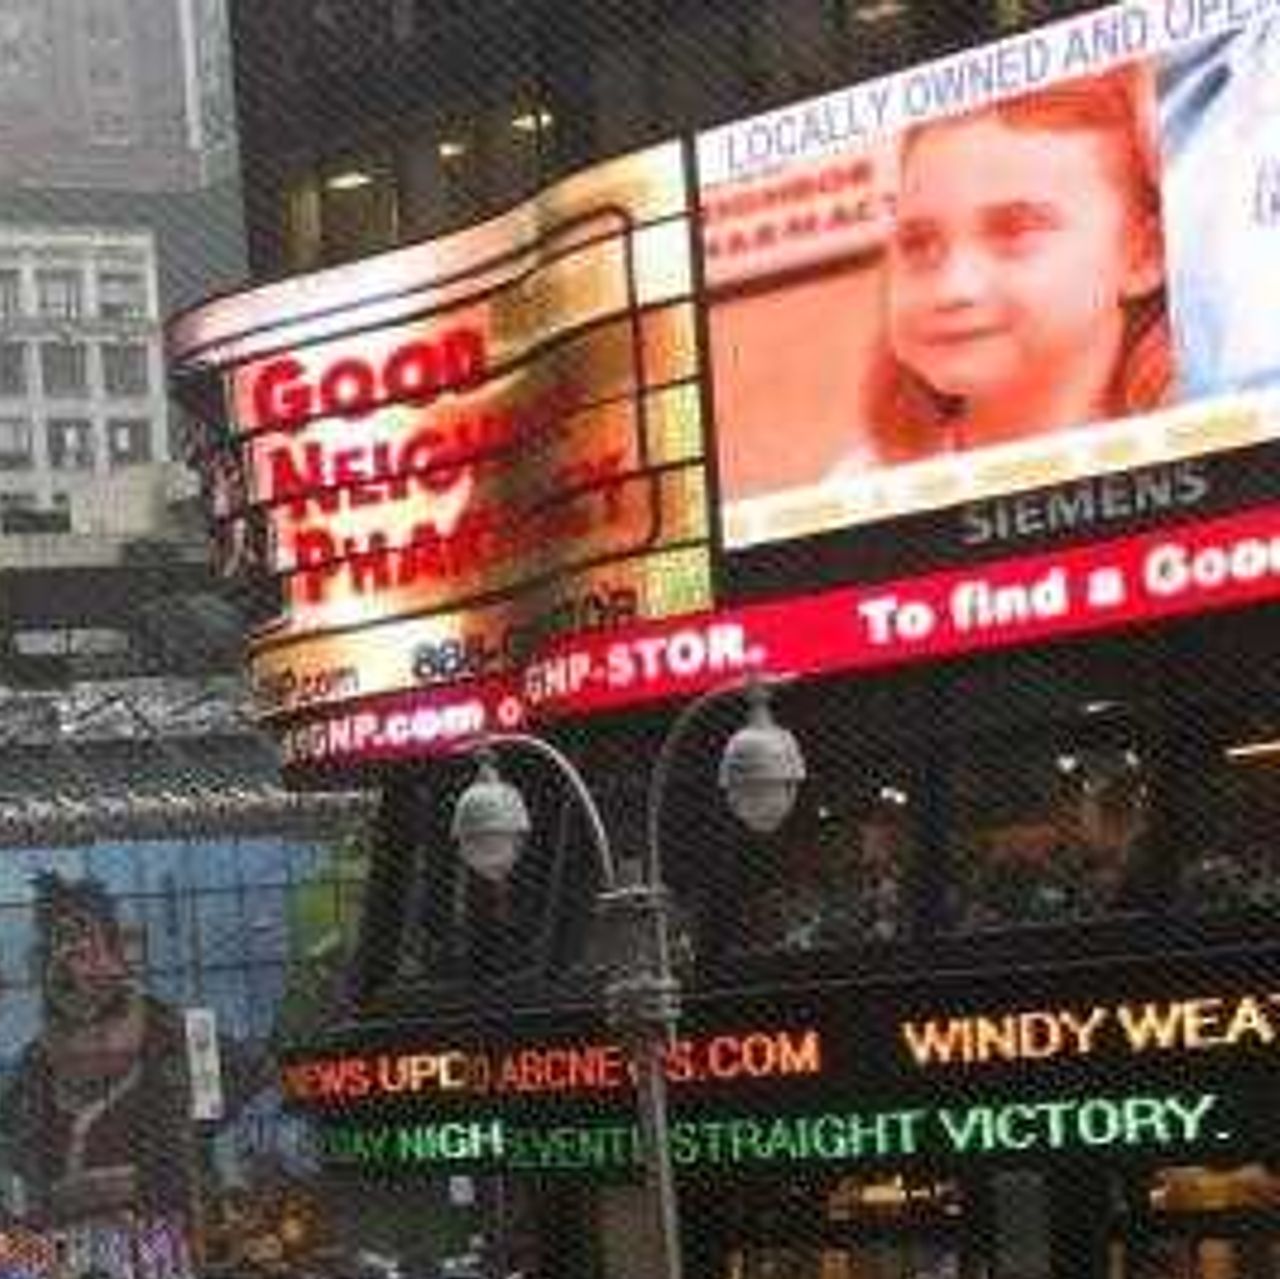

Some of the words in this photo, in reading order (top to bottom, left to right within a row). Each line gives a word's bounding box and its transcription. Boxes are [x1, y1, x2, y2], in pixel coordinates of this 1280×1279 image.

[726, 87, 892, 171] LOCALLY
[900, 35, 1053, 116] OWNED
[1060, 7, 1148, 67] AND
[962, 460, 1210, 546] SIEMENS
[858, 590, 936, 646] To
[948, 564, 1070, 636] find
[1086, 562, 1126, 608] a
[900, 1006, 1108, 1066] WINDY
[674, 1108, 928, 1166] STRAIGHT
[938, 1093, 1232, 1152] VICTORY.
